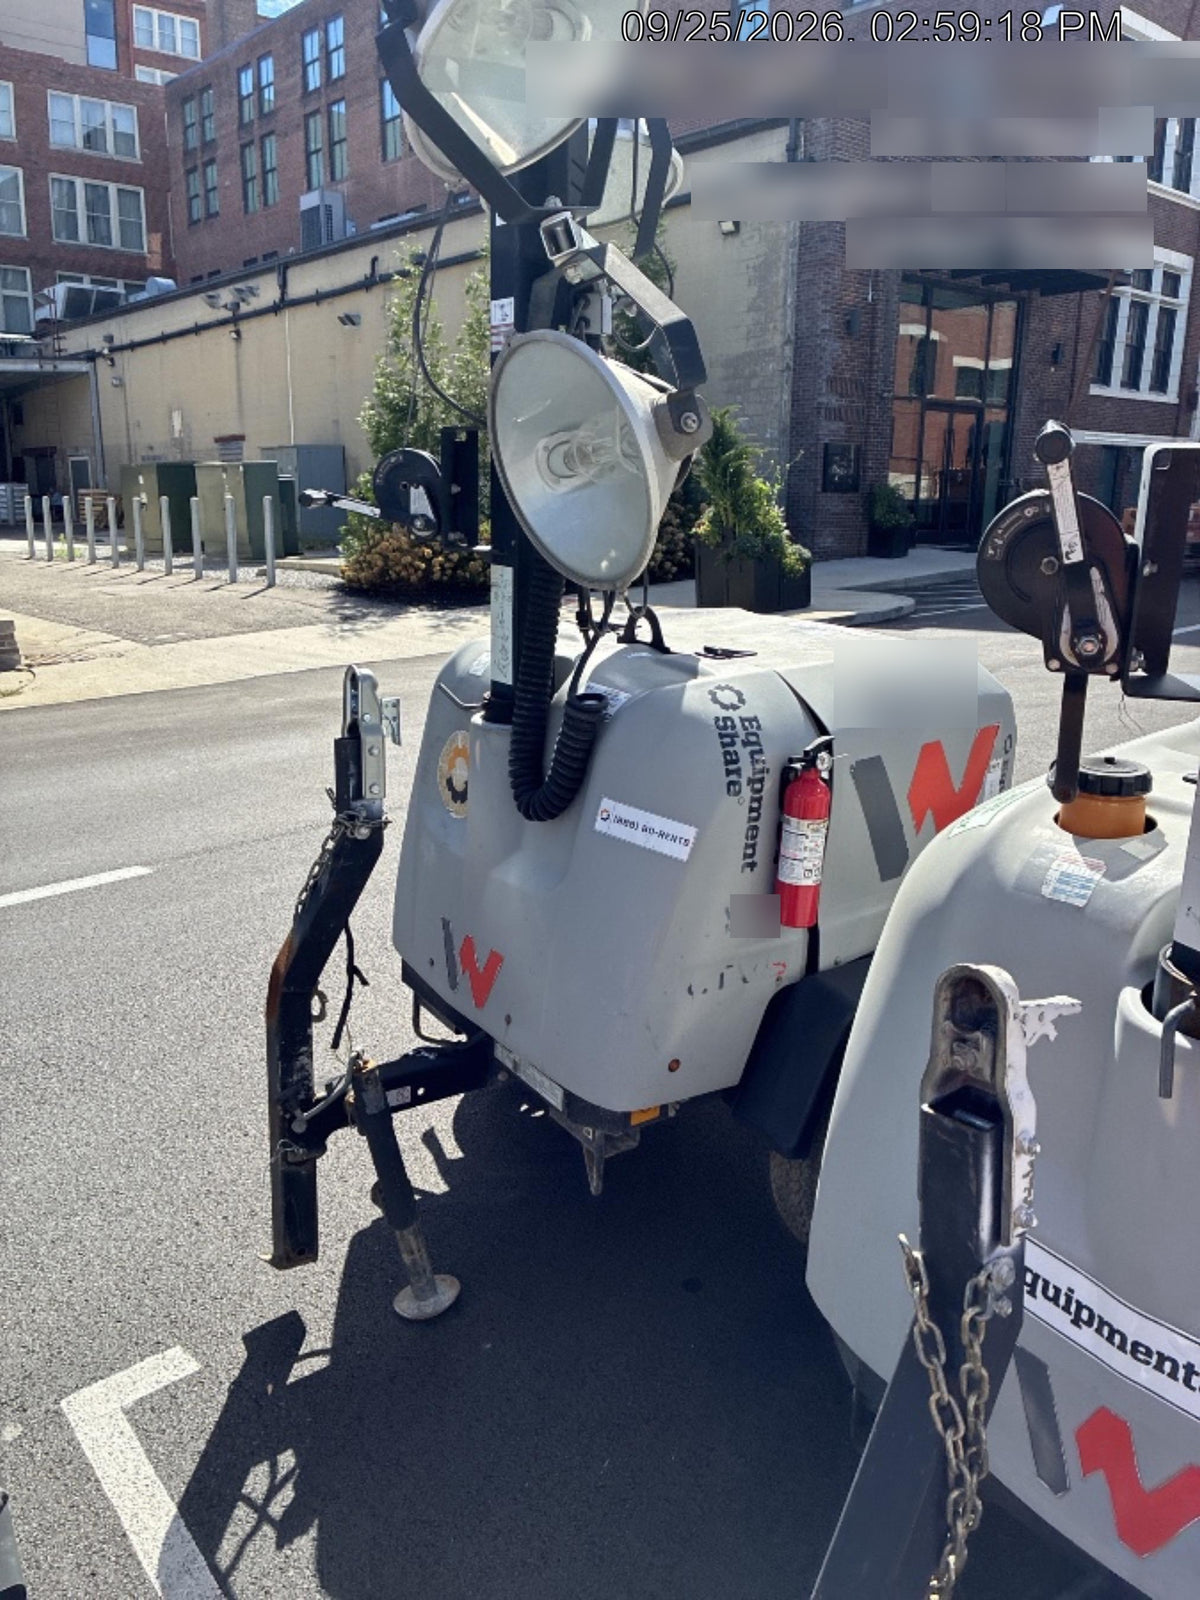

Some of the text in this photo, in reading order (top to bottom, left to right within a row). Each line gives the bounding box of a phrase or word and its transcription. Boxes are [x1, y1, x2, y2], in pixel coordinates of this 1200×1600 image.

[713, 715, 743, 797] Share
[739, 715, 770, 873] Equipment
[1024, 1265, 1200, 1392] quipment
